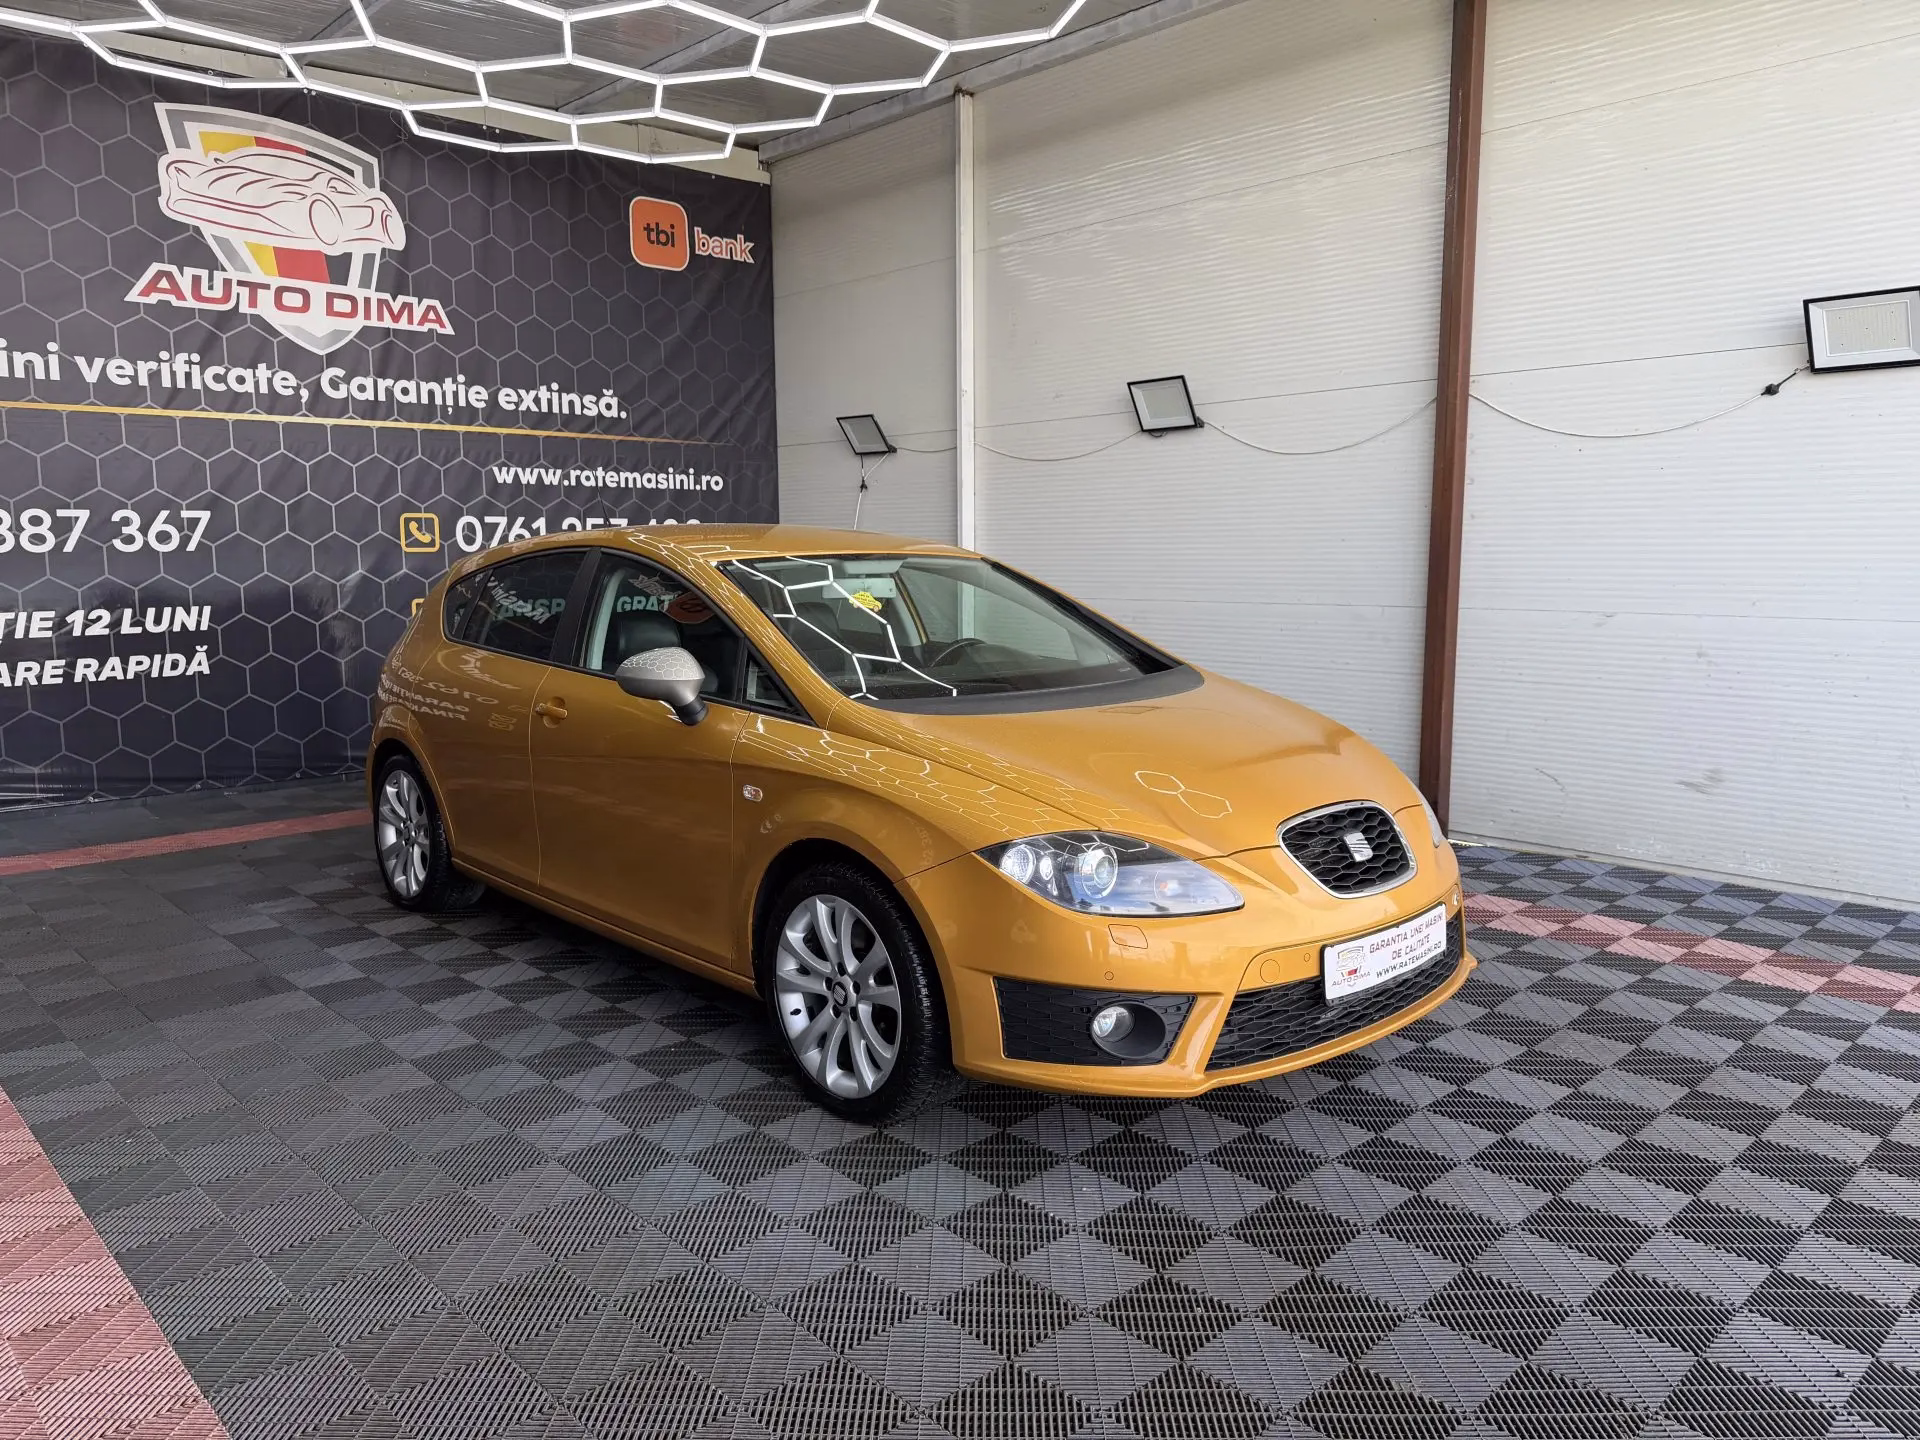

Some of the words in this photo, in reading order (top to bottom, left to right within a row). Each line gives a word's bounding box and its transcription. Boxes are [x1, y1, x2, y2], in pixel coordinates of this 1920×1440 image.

[643, 222, 675, 248] tbi
[694, 226, 754, 263] bank
[137, 269, 311, 314] AUTO
[326, 291, 447, 329] DIMA
[0, 337, 61, 381] ini
[74, 351, 309, 403] verificate,
[320, 366, 489, 415] Garanție
[498, 382, 627, 419] extinsă.
[492, 466, 724, 492] www.ratemasini.ro
[111, 509, 211, 552] 367
[456, 515, 547, 552] 0761
[65, 608, 111, 637] 12
[120, 605, 211, 635] LUNI
[74, 645, 210, 683] RAPIDĂ
[1369, 932, 1408, 954] GARANTIA
[1376, 941, 1442, 978] WWW.RATEMASINI.RO
[1391, 949, 1402, 961] DE
[1404, 933, 1431, 955] CALITATE
[1331, 976, 1351, 986] AUTO
[1353, 971, 1371, 981] DIMA
